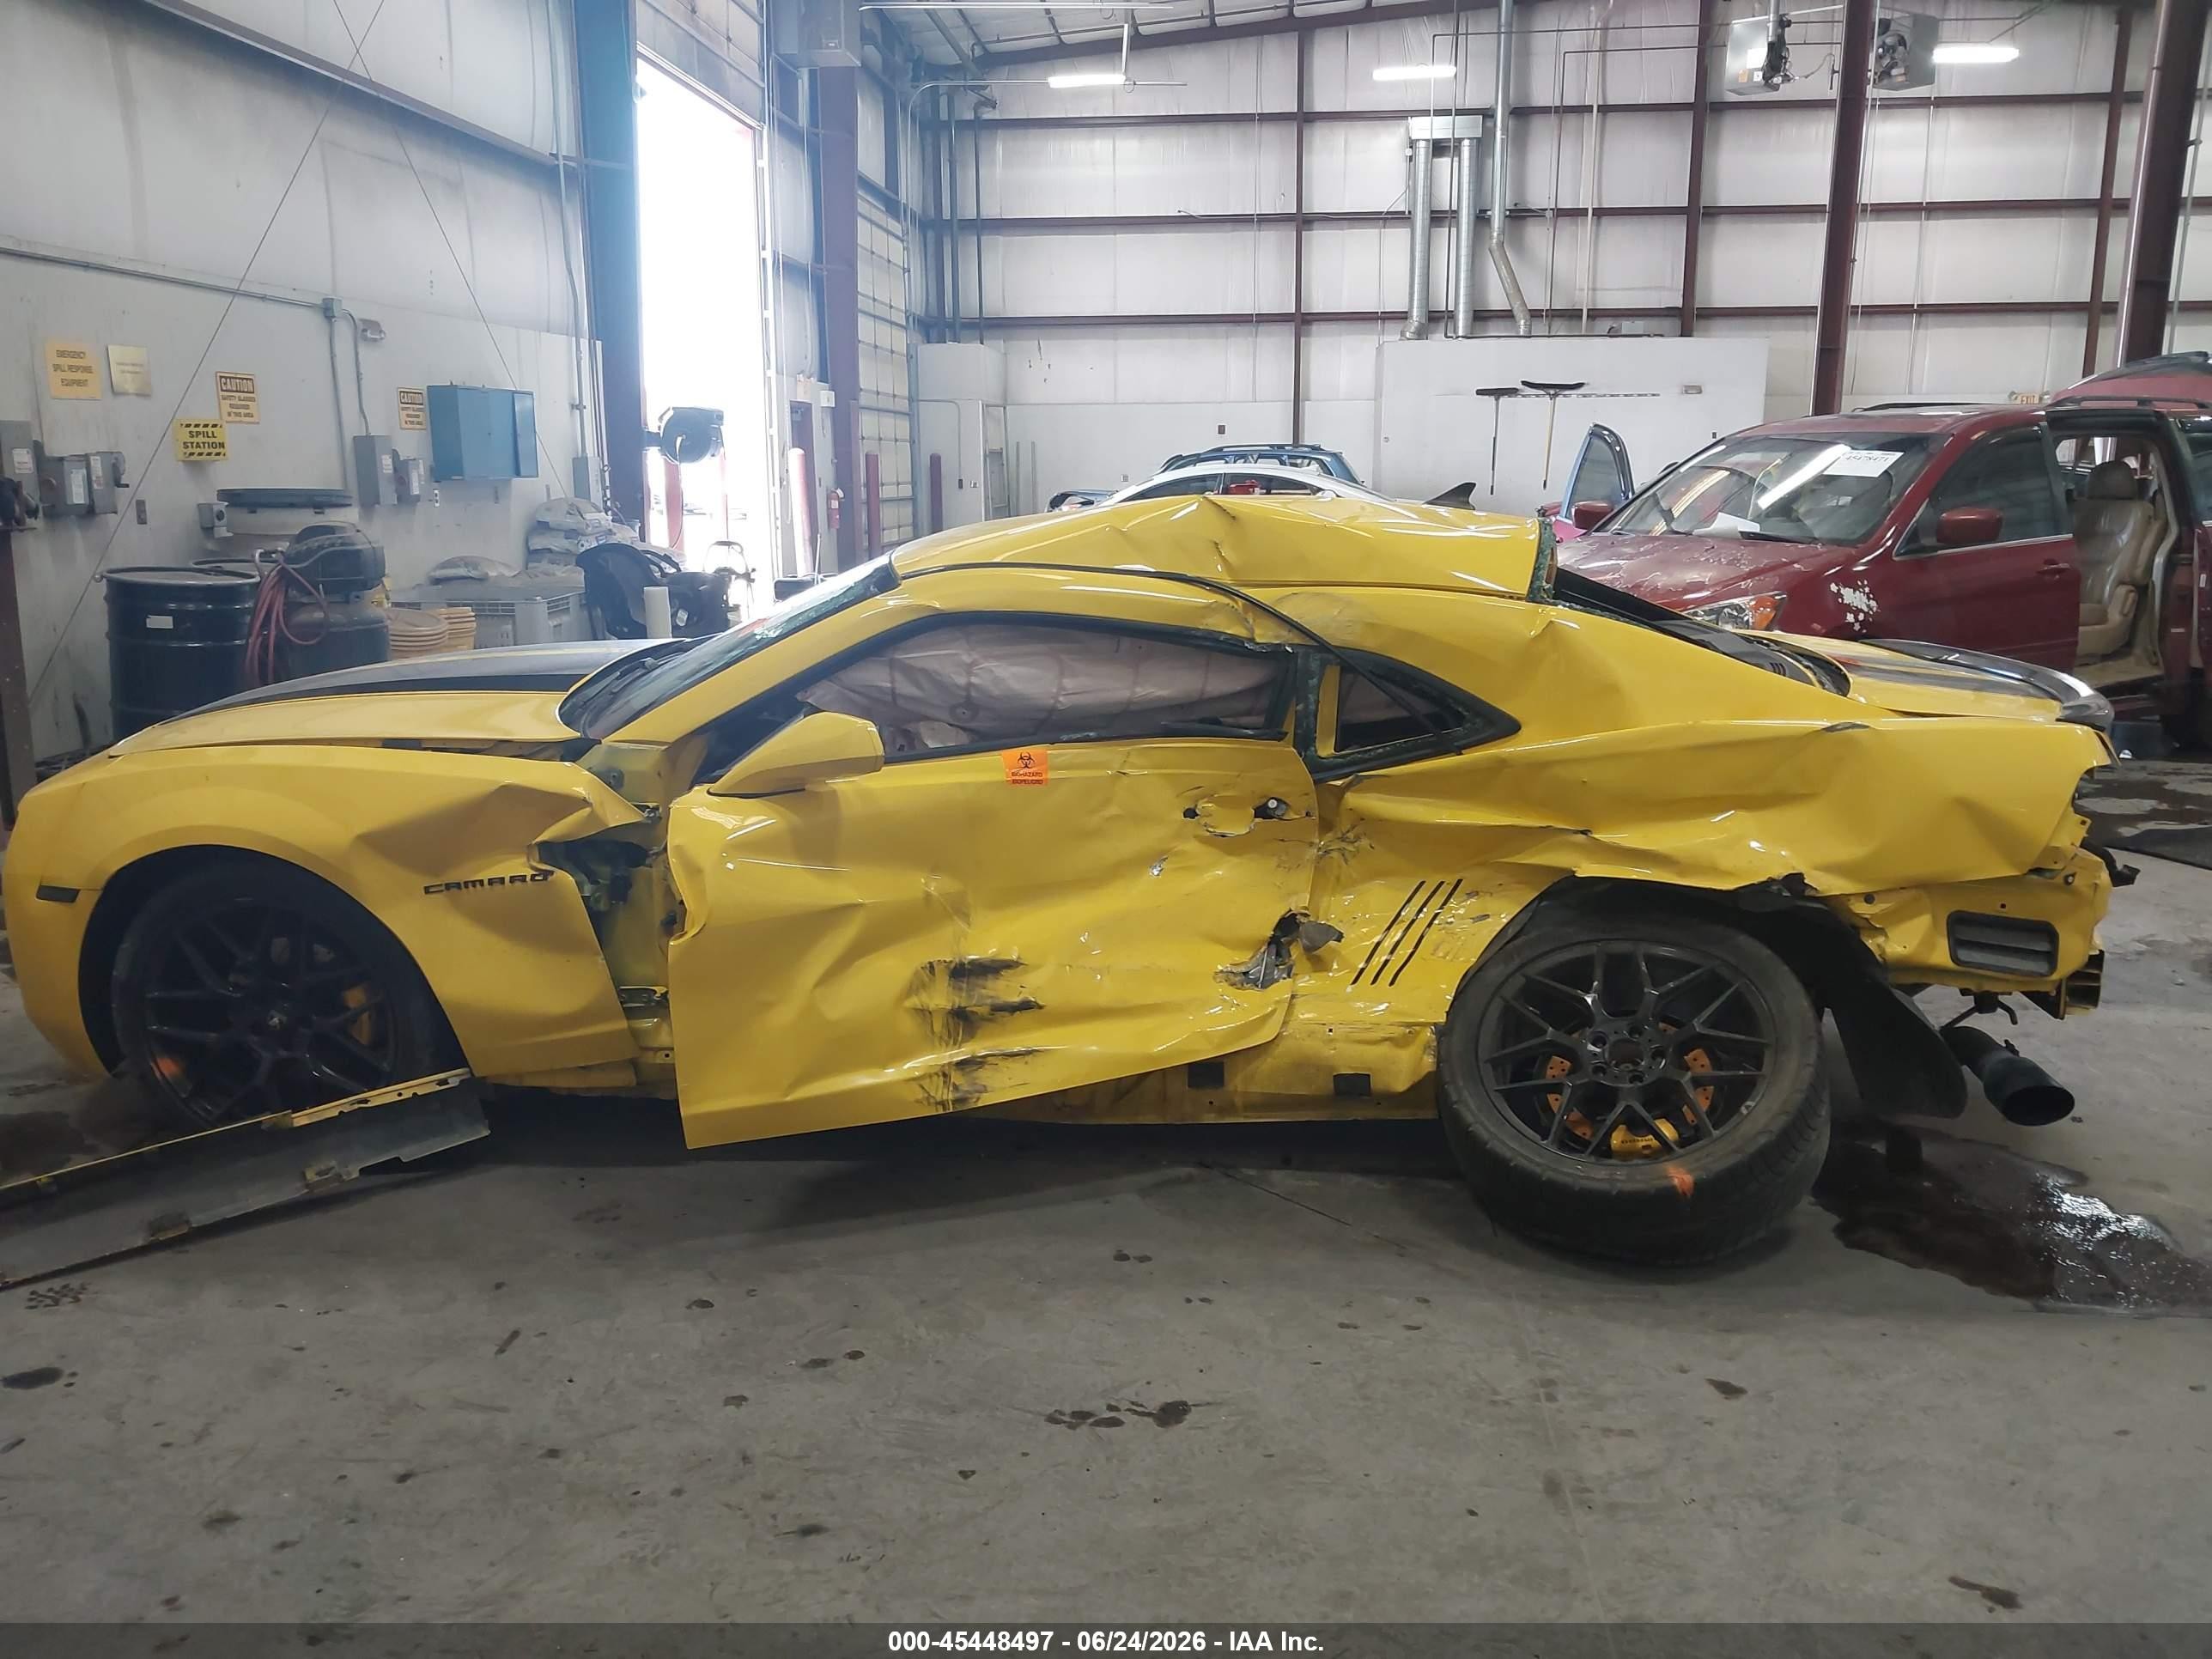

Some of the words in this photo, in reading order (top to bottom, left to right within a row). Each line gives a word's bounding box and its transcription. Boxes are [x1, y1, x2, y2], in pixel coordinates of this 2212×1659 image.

[221, 378, 253, 392] CAUTION
[188, 430, 217, 439] SPILL
[423, 872, 549, 895] CAMARO
